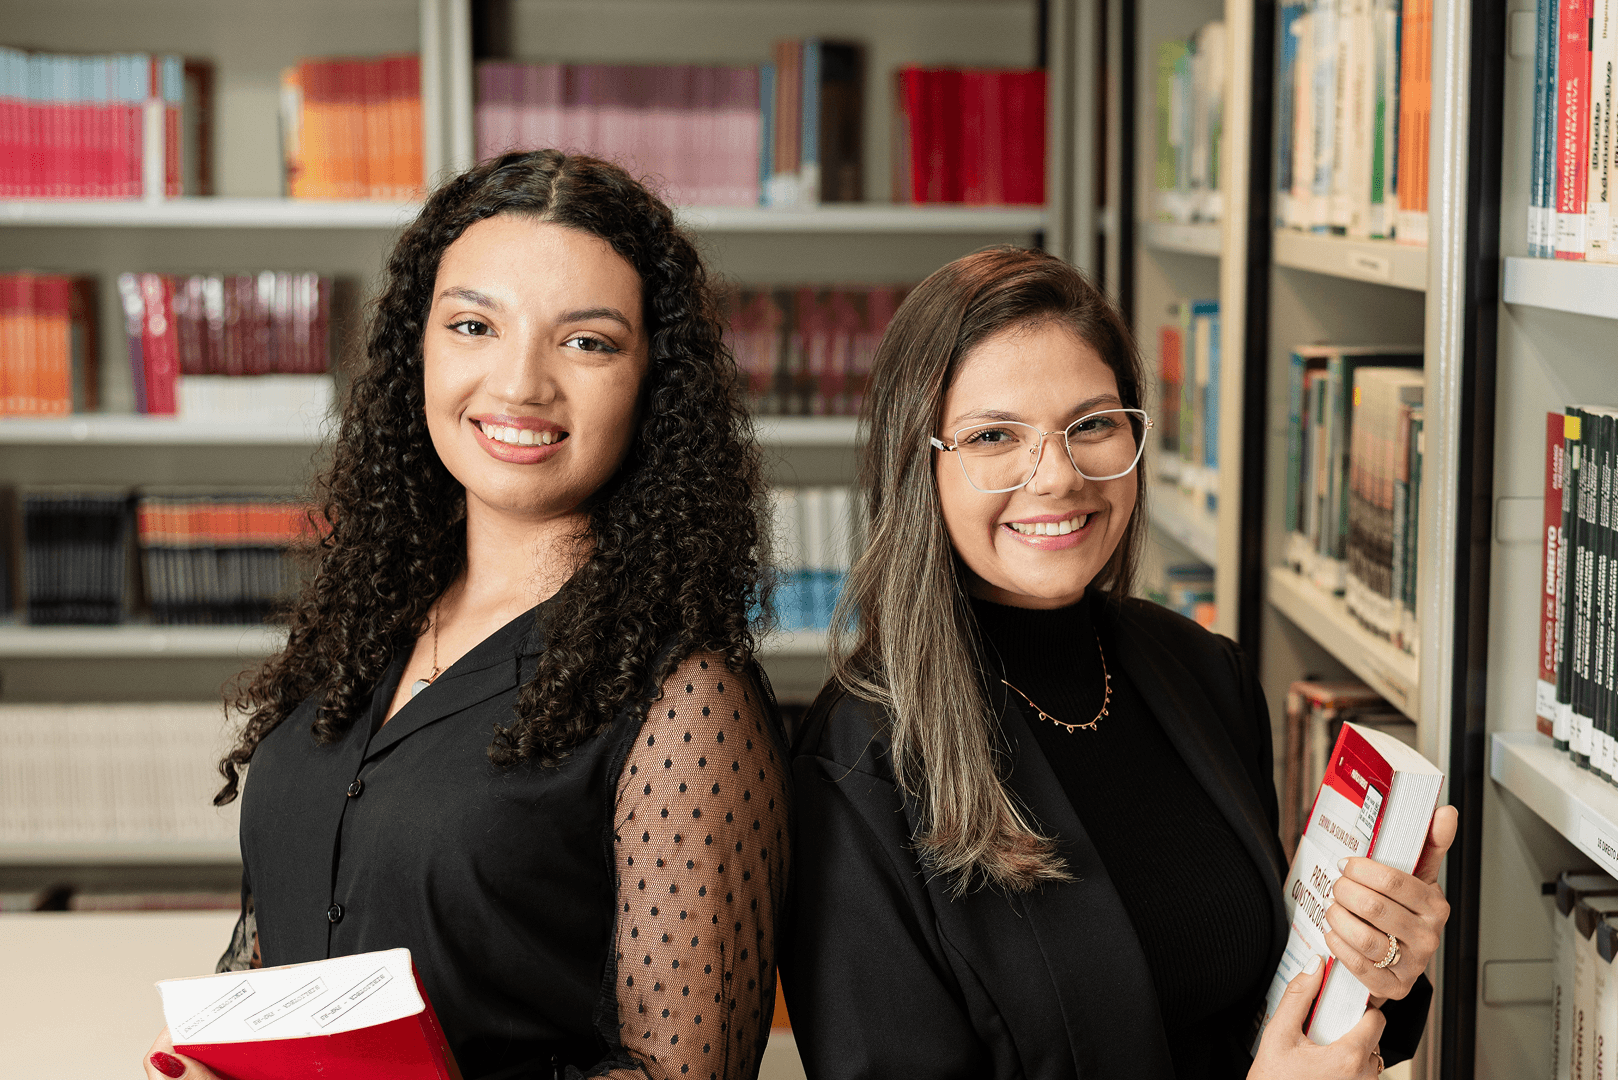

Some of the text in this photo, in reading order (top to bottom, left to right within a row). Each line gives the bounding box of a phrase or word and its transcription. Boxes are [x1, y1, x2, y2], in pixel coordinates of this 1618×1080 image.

[1592, 102, 1600, 170] Direito
[1601, 61, 1612, 203] Administrativo
[1546, 525, 1557, 595] DIREITO
[1545, 620, 1553, 671] CURSO
[1334, 825, 1345, 842] SILVA
[1343, 832, 1359, 853] OLIVEIRA
[1602, 840, 1617, 860] DIREITO
[282, 984, 321, 1009] BIBLIOTECA
[349, 973, 386, 1001] BIBLIOTECA
